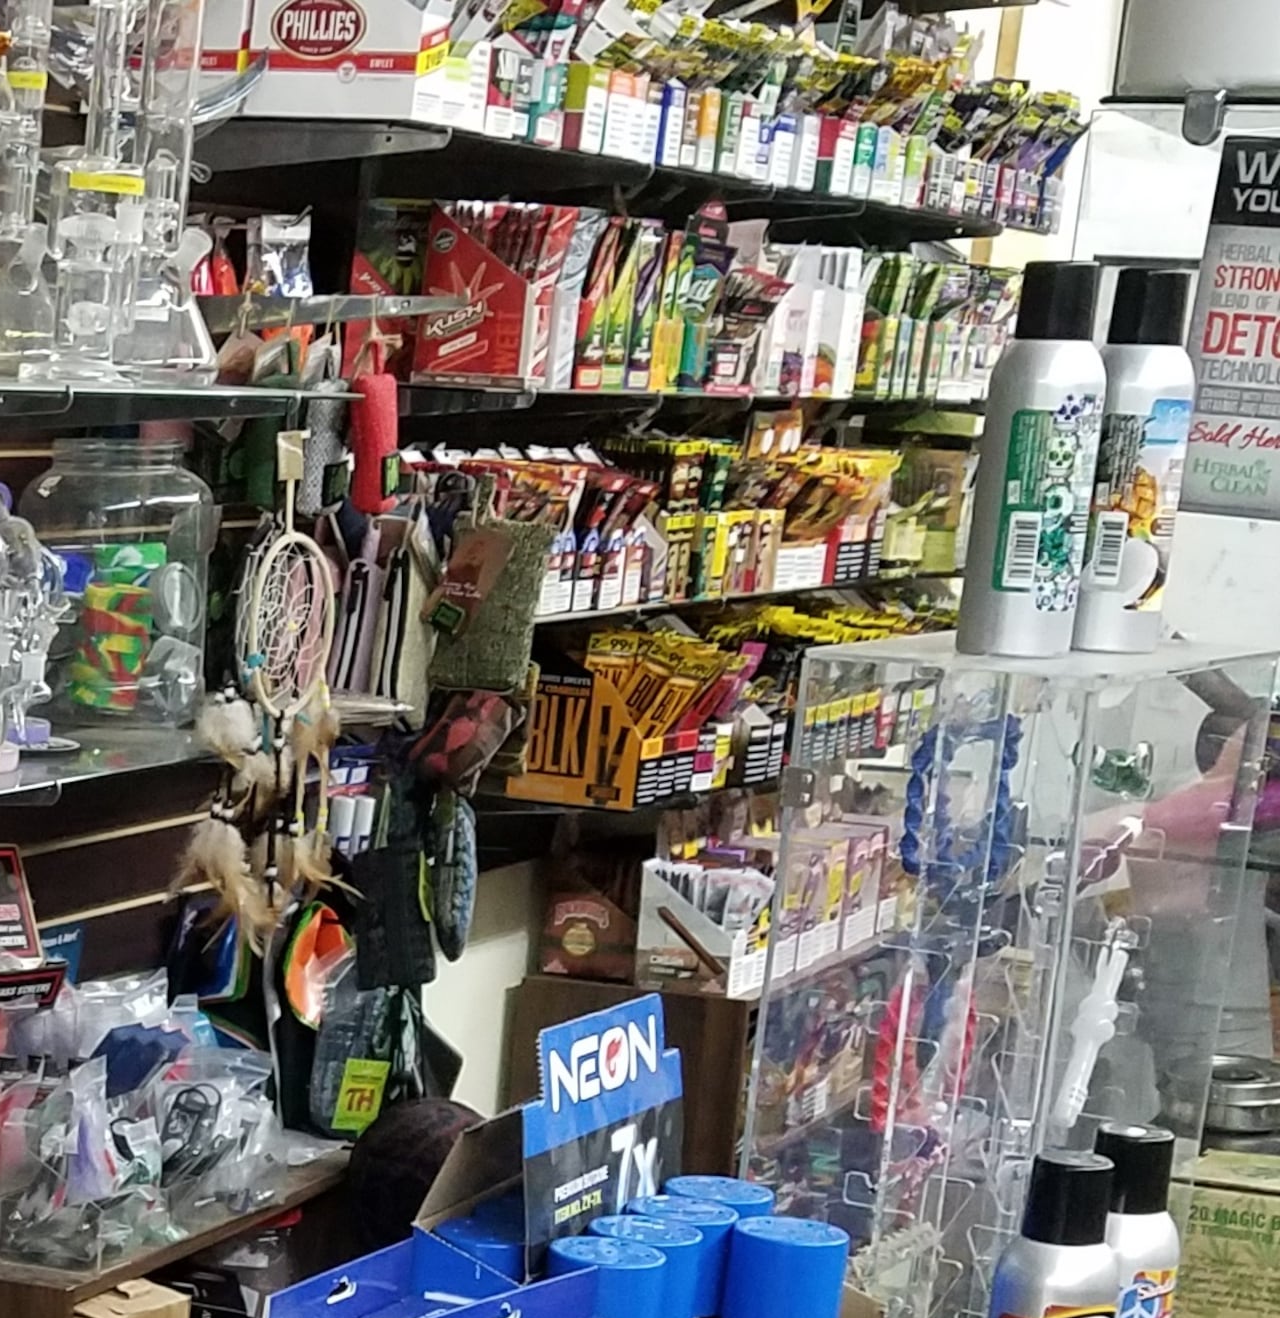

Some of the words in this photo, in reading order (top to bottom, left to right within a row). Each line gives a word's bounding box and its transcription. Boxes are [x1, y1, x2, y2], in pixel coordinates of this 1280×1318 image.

[281, 9, 357, 41] PHILLIES
[1214, 264, 1280, 292] STRON
[1201, 311, 1280, 358] DET
[1188, 420, 1242, 448] Sold
[1193, 457, 1256, 478] HERBAL
[1209, 477, 1269, 497] CLEAN
[526, 693, 587, 777] BLK
[548, 1013, 657, 1114] NEON
